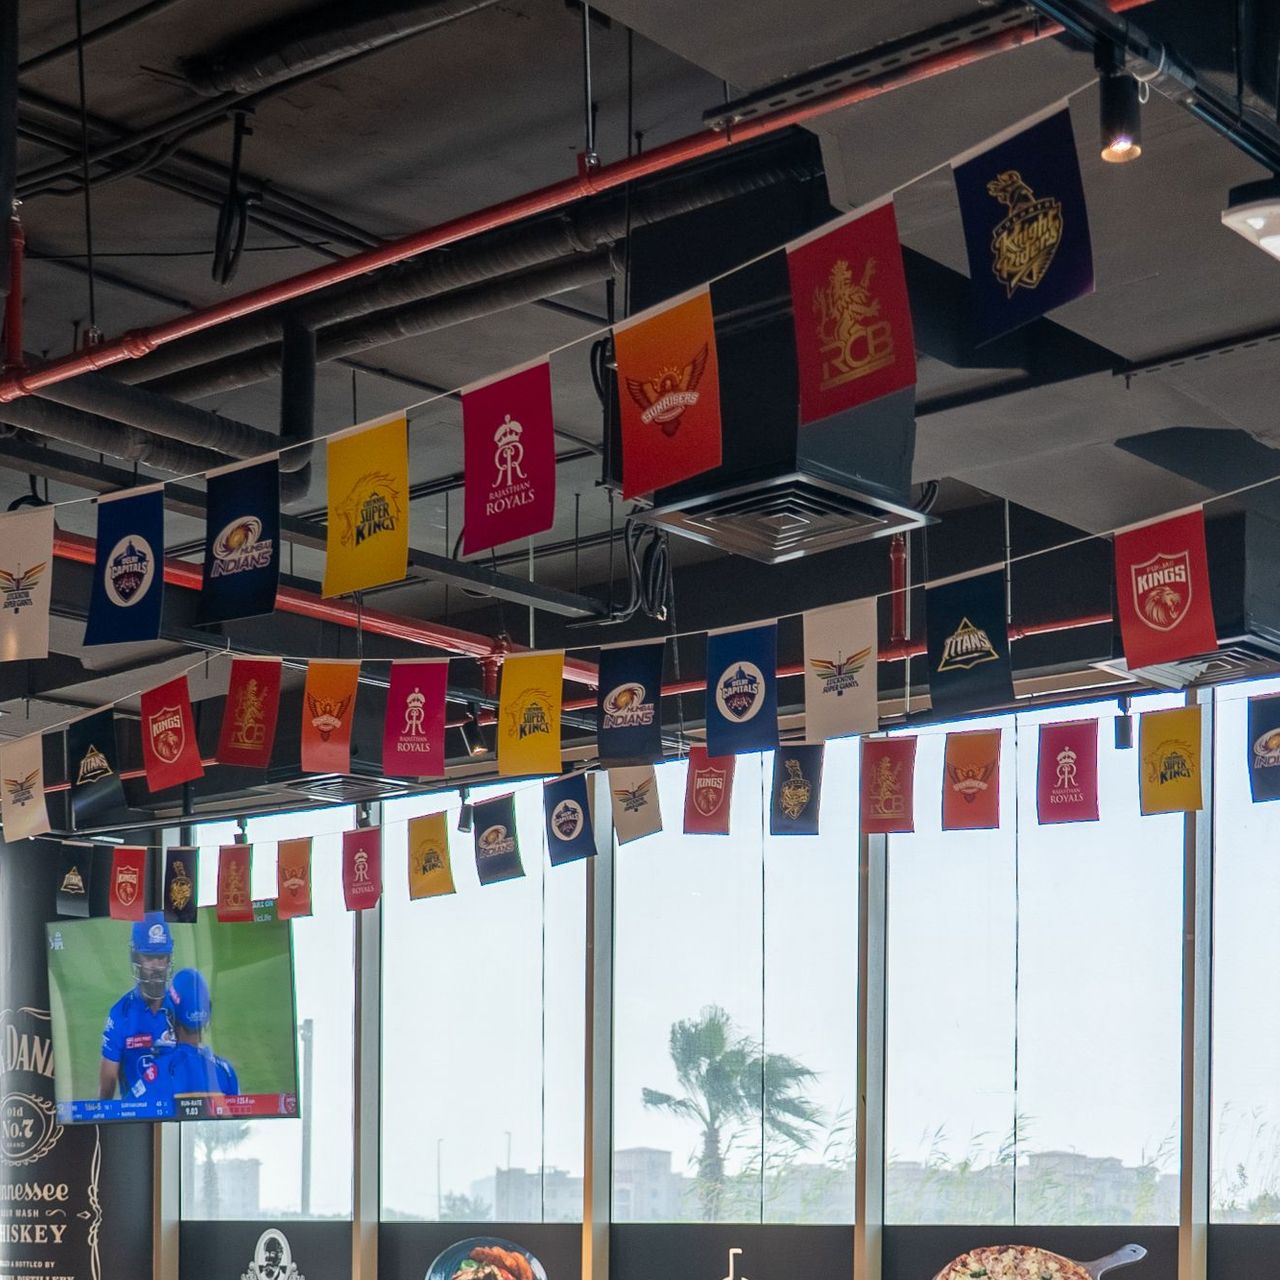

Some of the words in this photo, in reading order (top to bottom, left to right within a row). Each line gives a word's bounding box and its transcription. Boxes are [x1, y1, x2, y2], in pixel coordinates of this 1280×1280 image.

[822, 320, 893, 380] RCB
[641, 392, 699, 424] SUNRISERS
[489, 482, 530, 501] RAJASTHAN
[486, 489, 535, 516] ROYALS
[361, 503, 389, 524] SUPER
[356, 516, 395, 545] KINGS
[240, 543, 273, 555] MUMBAI
[111, 562, 147, 579] CAPITALS
[211, 553, 271, 577] INDIANS
[1137, 566, 1186, 594] KINGS
[945, 632, 991, 657] TITANS
[721, 682, 758, 697] CAPITALS
[627, 703, 654, 714] MUMBAI
[152, 715, 180, 737] KINGS
[523, 711, 546, 725] SUPER
[603, 711, 653, 729] INDIANS
[519, 721, 550, 738] KINGS
[397, 742, 430, 753] ROYALS
[80, 753, 108, 773] TITANS
[1163, 760, 1187, 772] SUPER
[697, 777, 723, 789] KINGS
[1159, 767, 1191, 785] KINGS
[1050, 793, 1084, 804] ROYALS
[352, 884, 375, 895] ROYALS
[185, 1107, 198, 1115] 9.03
[2, 1119, 34, 1138] No.7
[0, 1223, 67, 1243] HISKEY
